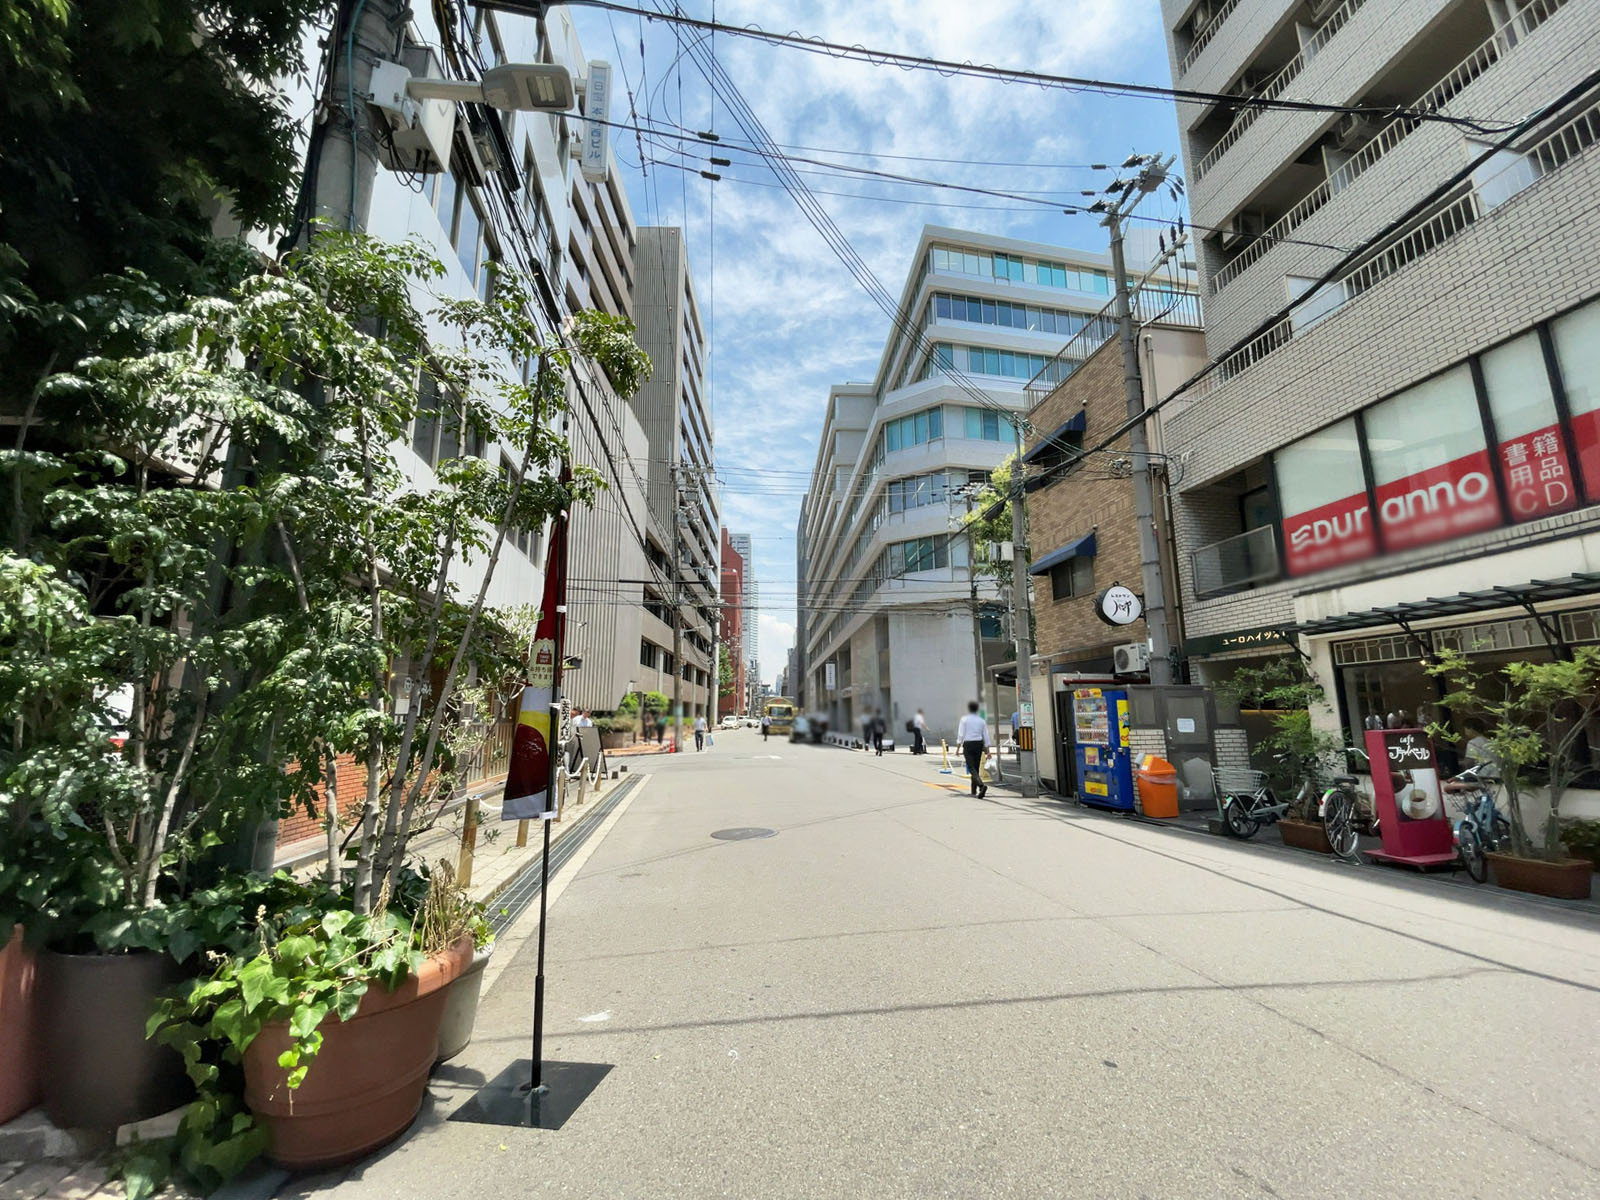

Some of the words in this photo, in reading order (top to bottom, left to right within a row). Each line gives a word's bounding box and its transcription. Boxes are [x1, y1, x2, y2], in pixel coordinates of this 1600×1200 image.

[1504, 432, 1559, 467] 書籍
[1510, 456, 1564, 489] 用品
[1515, 481, 1568, 513] CD
[1222, 630, 1287, 646] ユーロハイツ
